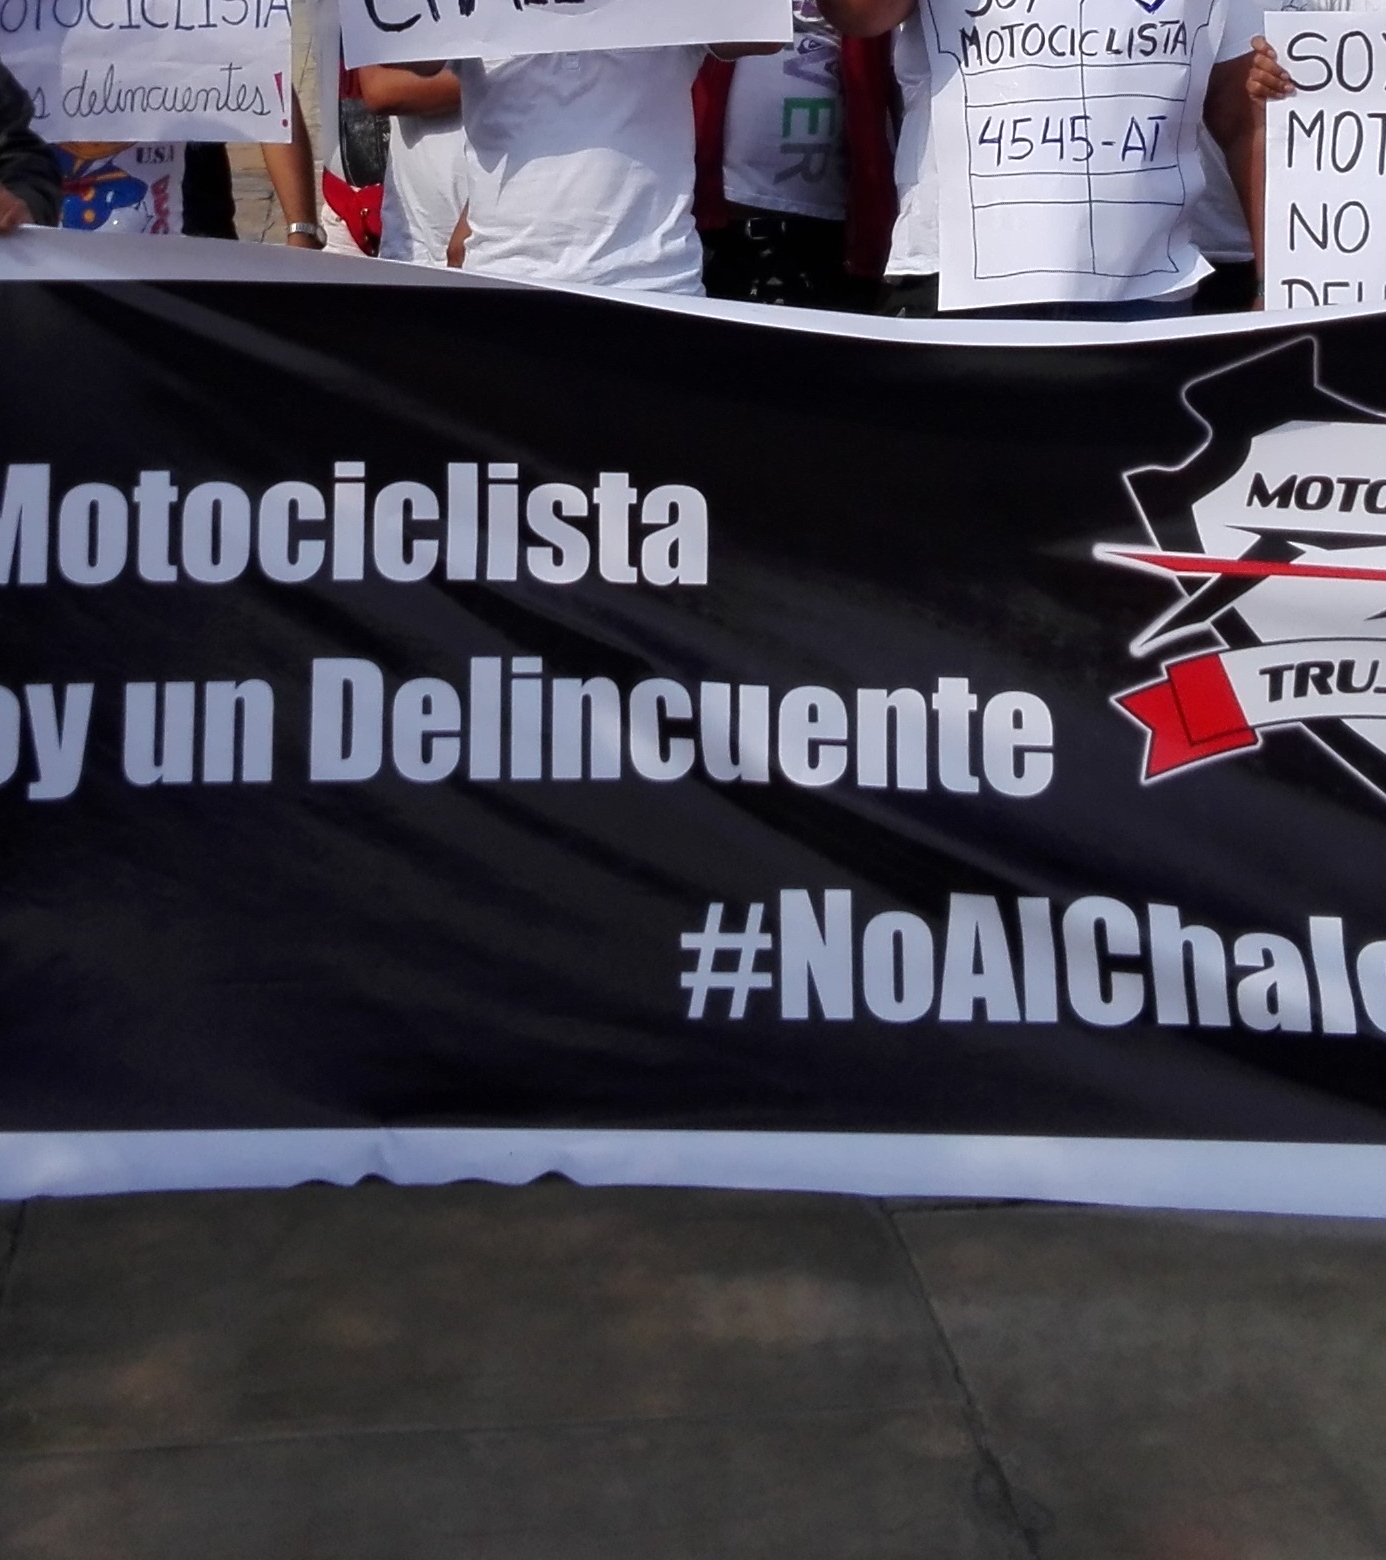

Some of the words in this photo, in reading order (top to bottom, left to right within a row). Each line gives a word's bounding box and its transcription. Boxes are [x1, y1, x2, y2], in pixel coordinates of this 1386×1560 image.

[959, 20, 1187, 67] MOTOCICLISTA
[978, 114, 1166, 166] 4545-AT
[1289, 201, 1370, 254] NO
[123, 678, 273, 785] un
[310, 656, 1055, 797] Delincuente
